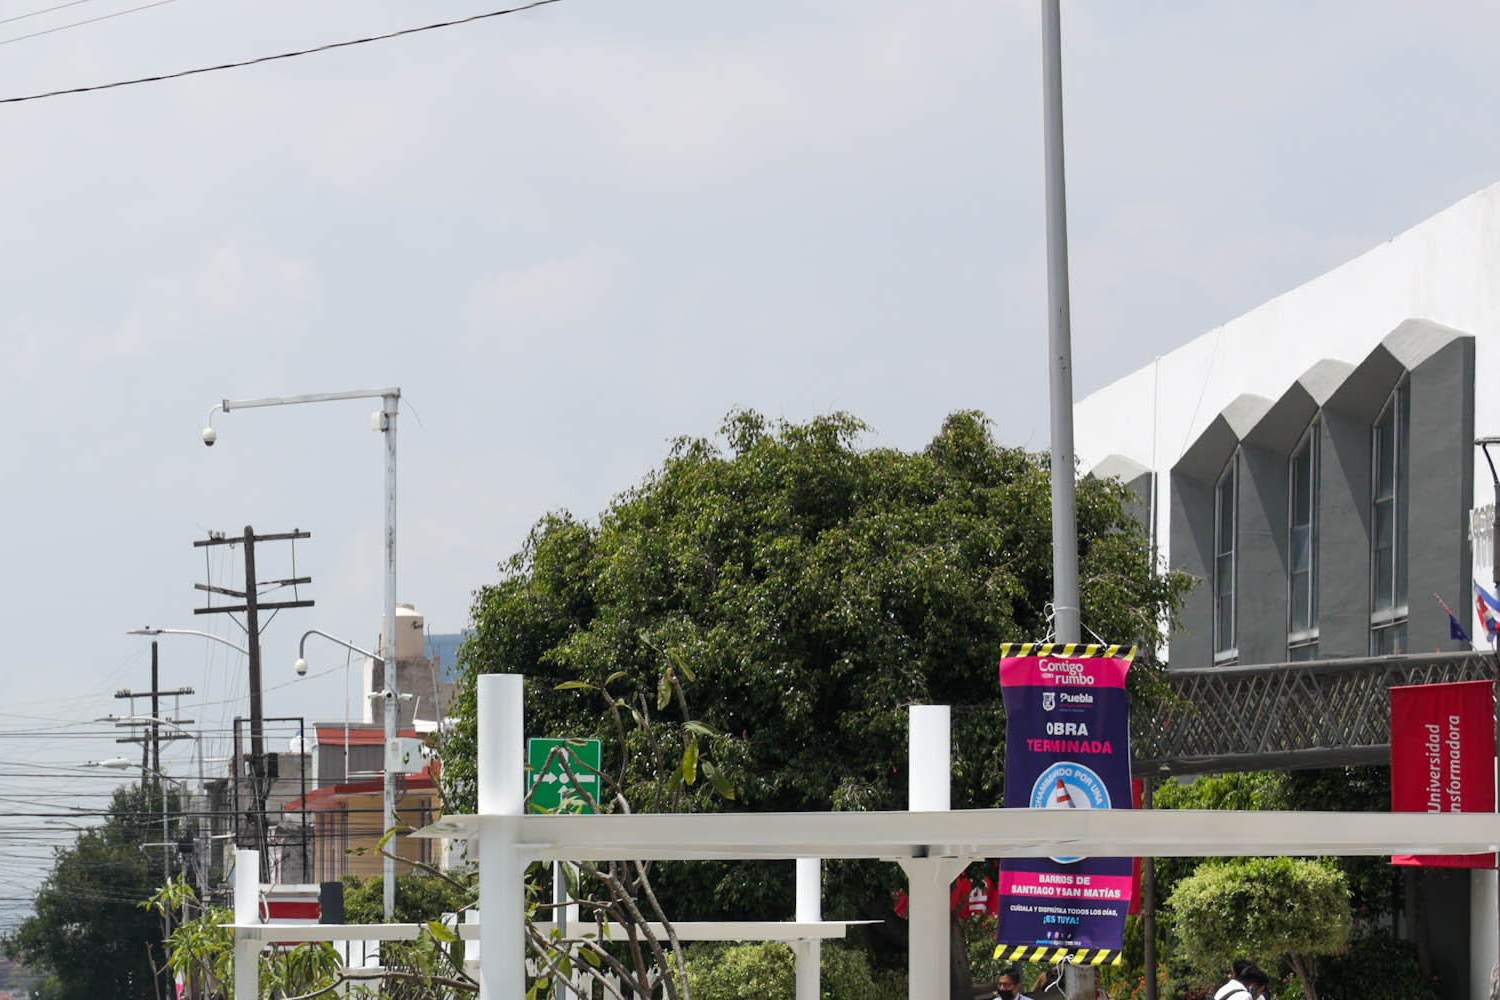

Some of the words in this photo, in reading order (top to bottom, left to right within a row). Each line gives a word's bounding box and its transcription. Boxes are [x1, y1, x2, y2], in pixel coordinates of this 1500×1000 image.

[1038, 659, 1084, 675] Contigo
[1056, 674, 1094, 684] rumbo
[1060, 693, 1093, 703] Puebla
[1046, 722, 1088, 736] OBRA
[1028, 739, 1112, 754] TERMINADA
[1425, 724, 1441, 813] Universidad
[1446, 715, 1462, 812] nsformadora
[1075, 770, 1093, 786] POR
[1090, 784, 1104, 805] UNA
[1076, 876, 1090, 886] DE
[1012, 885, 1054, 896] SANTIAGO
[1056, 887, 1062, 896] Y
[1062, 887, 1082, 897] SAN
[1084, 887, 1121, 898] MATÍAS
[1068, 908, 1089, 916] TODOS
[1090, 908, 1102, 916] LOS
